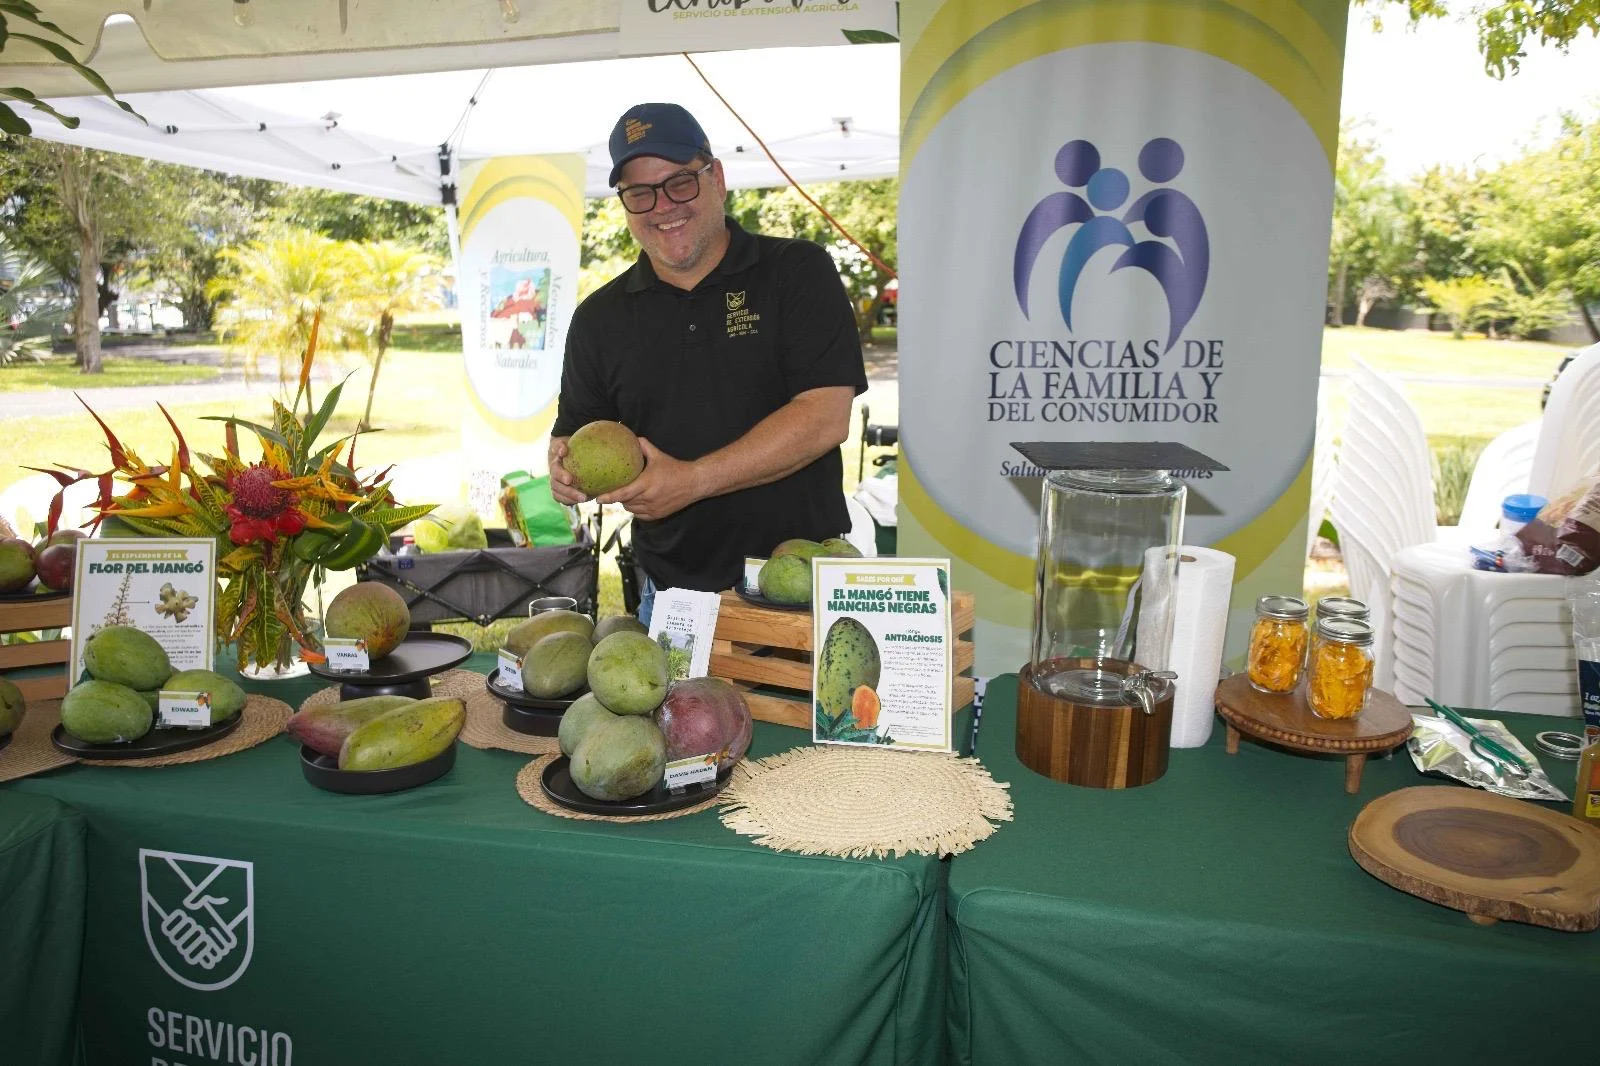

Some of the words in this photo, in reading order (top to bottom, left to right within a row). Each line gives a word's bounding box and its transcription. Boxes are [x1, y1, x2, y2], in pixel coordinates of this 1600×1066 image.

[673, 9, 721, 19] SERVICIO
[724, 8, 738, 17] DE
[990, 339, 1160, 368] CIENCIAS
[1182, 340, 1224, 368] DE
[495, 353, 538, 370] Naturales
[988, 371, 1032, 399] LA
[1042, 371, 1188, 399] FAMILIA
[1198, 371, 1223, 400] Y
[987, 401, 1035, 422] DEL
[1041, 401, 1219, 423] CONSUMIDOR
[89, 563, 123, 574] FLOR
[126, 563, 150, 574] DEL
[152, 560, 204, 574] MANGÓ
[833, 588, 846, 600] EL
[847, 588, 893, 601] MANGÓ
[895, 590, 930, 602] TIENE
[827, 600, 885, 612] MANCHAS
[887, 602, 937, 614] NEGRAS
[885, 634, 943, 643] ANTRACNOSIS
[669, 771, 689, 779] DAVIS
[147, 1007, 293, 1066] SERVICIO
